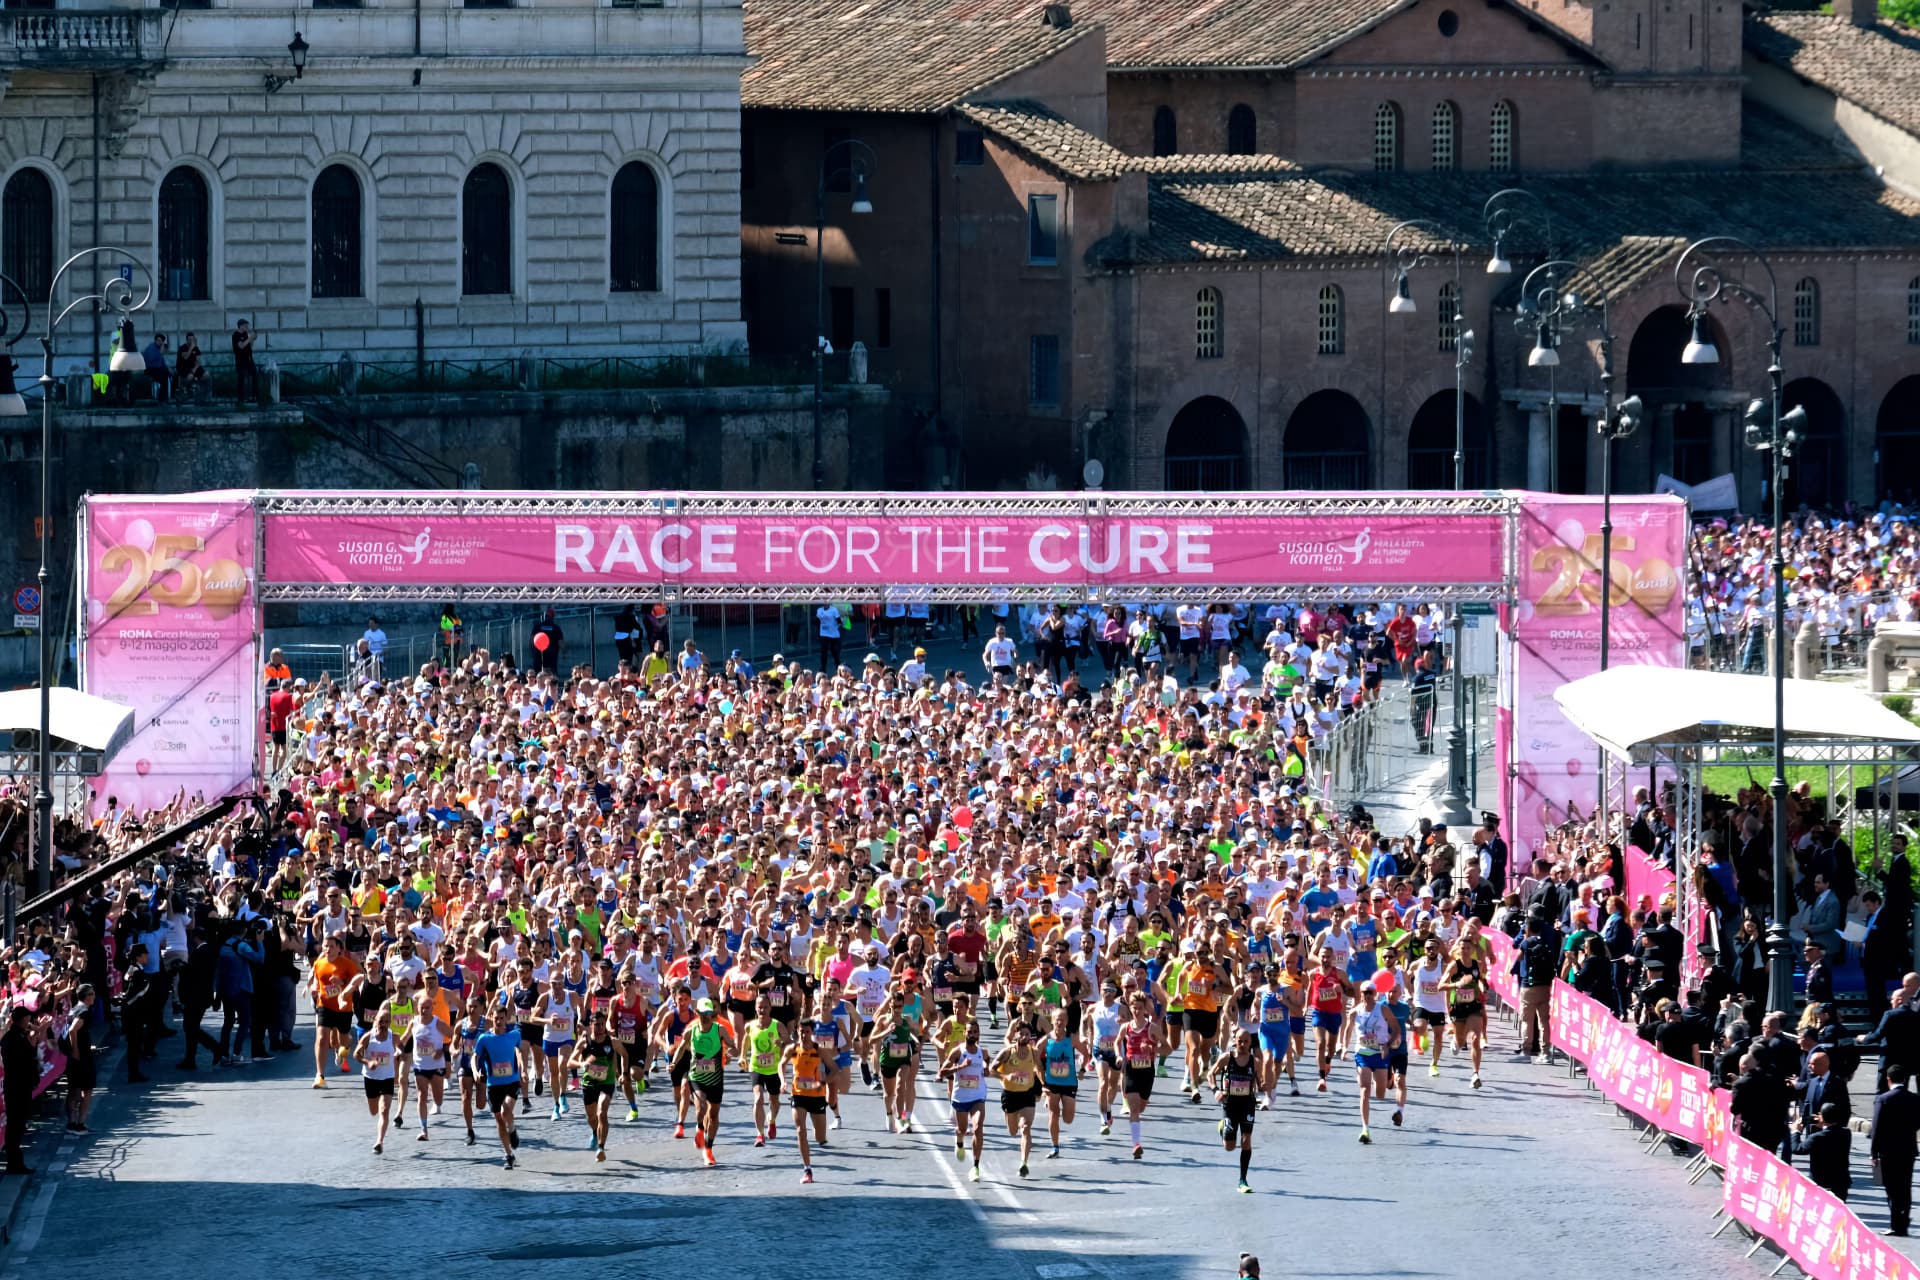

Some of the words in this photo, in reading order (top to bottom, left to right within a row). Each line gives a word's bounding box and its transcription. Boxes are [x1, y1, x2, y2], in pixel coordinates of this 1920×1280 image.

[122, 267, 129, 278] P
[337, 541, 385, 553] susan
[386, 541, 397, 553] G.
[554, 524, 738, 574] RACE
[764, 525, 881, 574] FOR
[898, 526, 1009, 573] THE
[1028, 524, 1214, 574] CURE
[1278, 542, 1325, 554] susan
[1326, 542, 1337, 554] G.
[101, 535, 205, 618] 25
[1532, 534, 1636, 618] 25
[119, 630, 152, 639] ROMA
[1550, 630, 1584, 639] ROMA
[119, 639, 142, 650] 9-12
[144, 641, 188, 652] maggio
[189, 639, 219, 651] 2024
[1619, 640, 1650, 650] 2024
